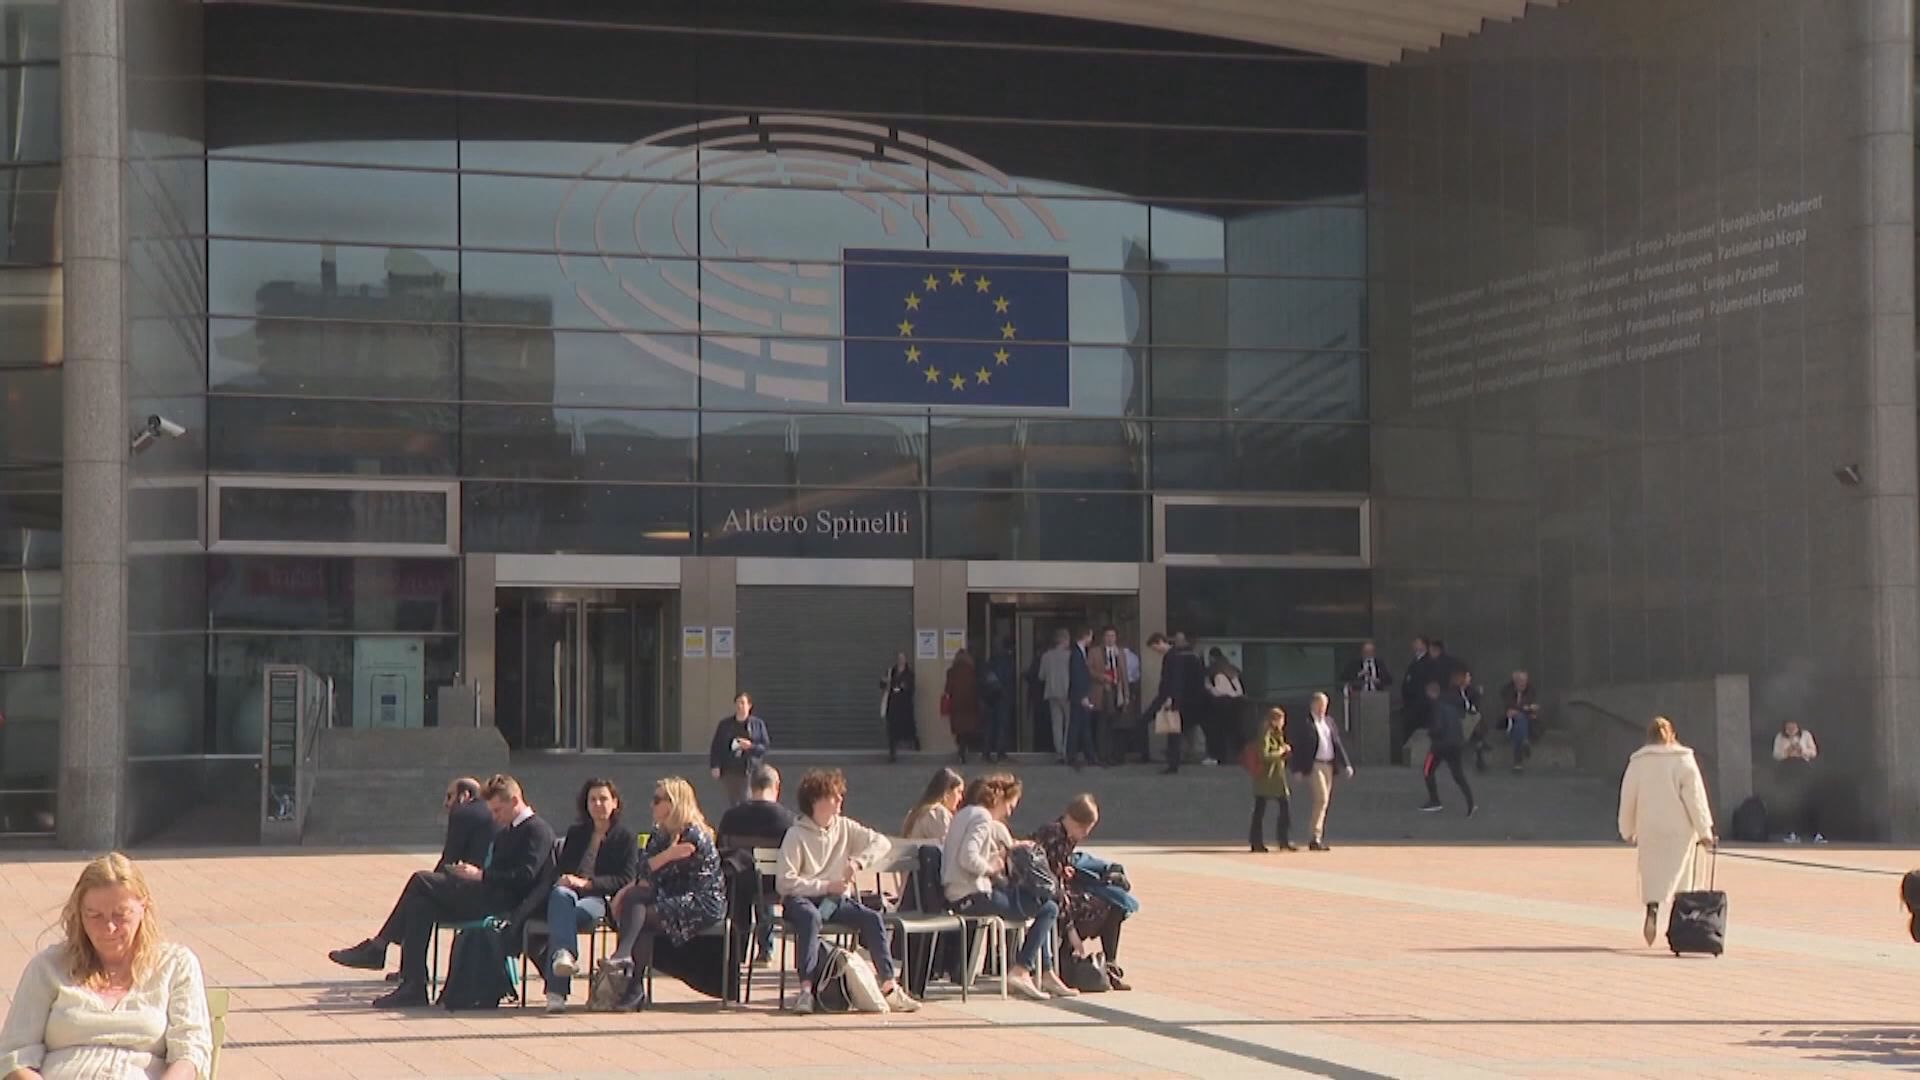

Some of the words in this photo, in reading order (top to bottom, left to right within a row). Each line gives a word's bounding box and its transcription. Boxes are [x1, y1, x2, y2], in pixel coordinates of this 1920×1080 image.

[1776, 195, 1822, 219] Parlament
[1735, 260, 1779, 284] Parlament
[722, 508, 808, 533] Altiero
[816, 510, 909, 539] Spinelli
